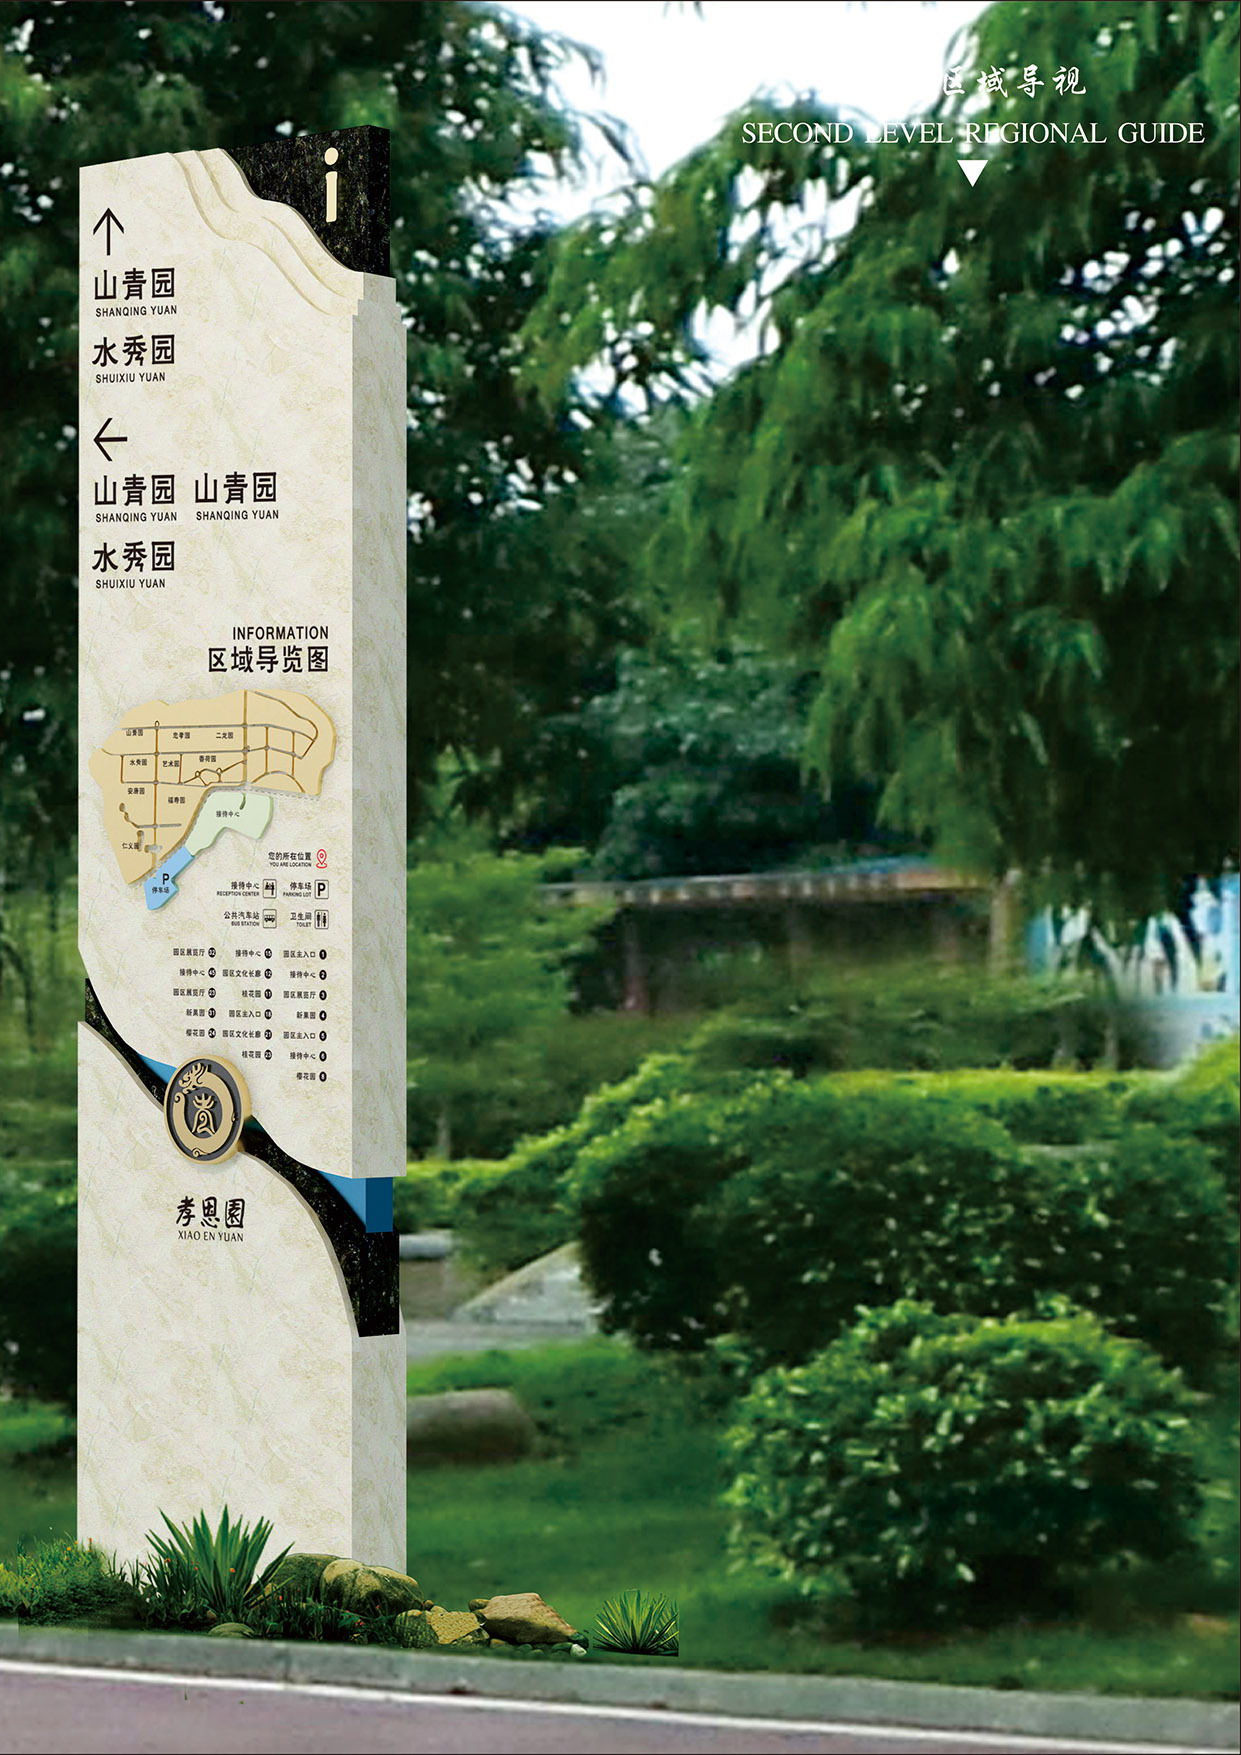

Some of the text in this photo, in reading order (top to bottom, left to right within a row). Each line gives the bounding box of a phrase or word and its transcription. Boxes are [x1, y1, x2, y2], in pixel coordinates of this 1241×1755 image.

[94, 267, 175, 301] 山青园
[95, 305, 177, 318] SHANQING YUAN
[91, 334, 175, 368] 水秀园
[95, 372, 166, 384] SHUIXIU YUAN
[94, 471, 277, 507] 山青园 山青园
[95, 509, 279, 523] SHANQING YUAN SHANQING YUAN
[91, 540, 175, 573] 水秀园
[95, 578, 166, 589] SHUIXIU YUAN
[232, 625, 329, 641] INFORMATION
[208, 645, 329, 674] 区域导览图
[162, 760, 180, 768] 艺术园
[216, 810, 240, 818] 接待中心
[267, 851, 312, 861] 您的所在位置
[162, 873, 170, 885] P
[151, 886, 170, 894] 停车场
[230, 881, 260, 891] 接待中心
[289, 881, 312, 891] 停车场
[223, 911, 260, 921] 公共汽车站
[289, 912, 312, 921] 卫生间
[235, 949, 261, 958] 接待中心
[283, 950, 316, 959] 园区主入口
[179, 968, 206, 978] 接待中心
[289, 970, 316, 980] 接待中心
[229, 1009, 261, 1018] 园区主入口
[283, 1031, 316, 1041] 园区主入口
[289, 1051, 316, 1061] 接待中心
[175, 1195, 246, 1229] 孝恩園
[177, 1230, 244, 1243] XIAO EN YUAN
